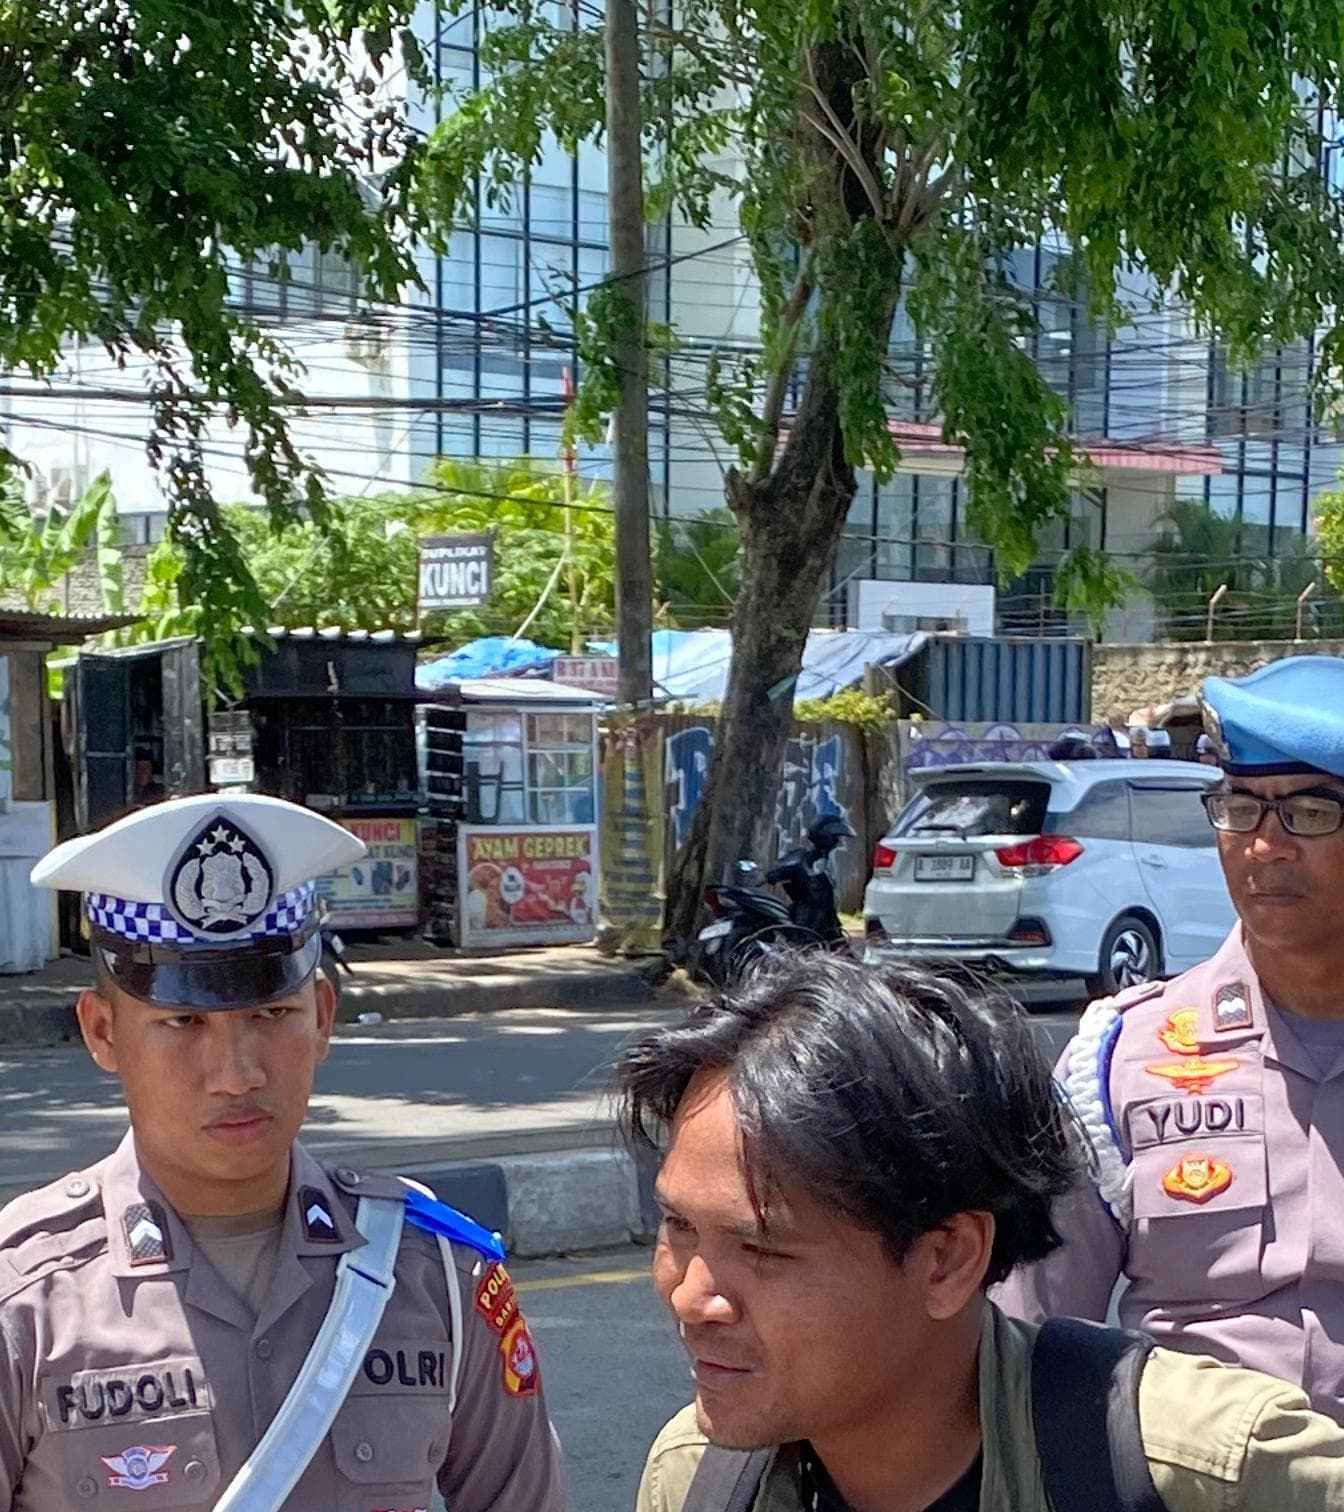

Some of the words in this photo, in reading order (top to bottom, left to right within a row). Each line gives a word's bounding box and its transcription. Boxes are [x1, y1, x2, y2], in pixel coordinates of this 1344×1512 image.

[418, 561, 488, 597] KUNCI
[472, 837, 519, 860] AYAM
[523, 836, 586, 858] GEPREK
[1146, 1098, 1245, 1144] YUDI
[480, 1263, 511, 1310] POL
[363, 1349, 445, 1388] OLRI
[57, 1367, 197, 1423] FUDOLI
